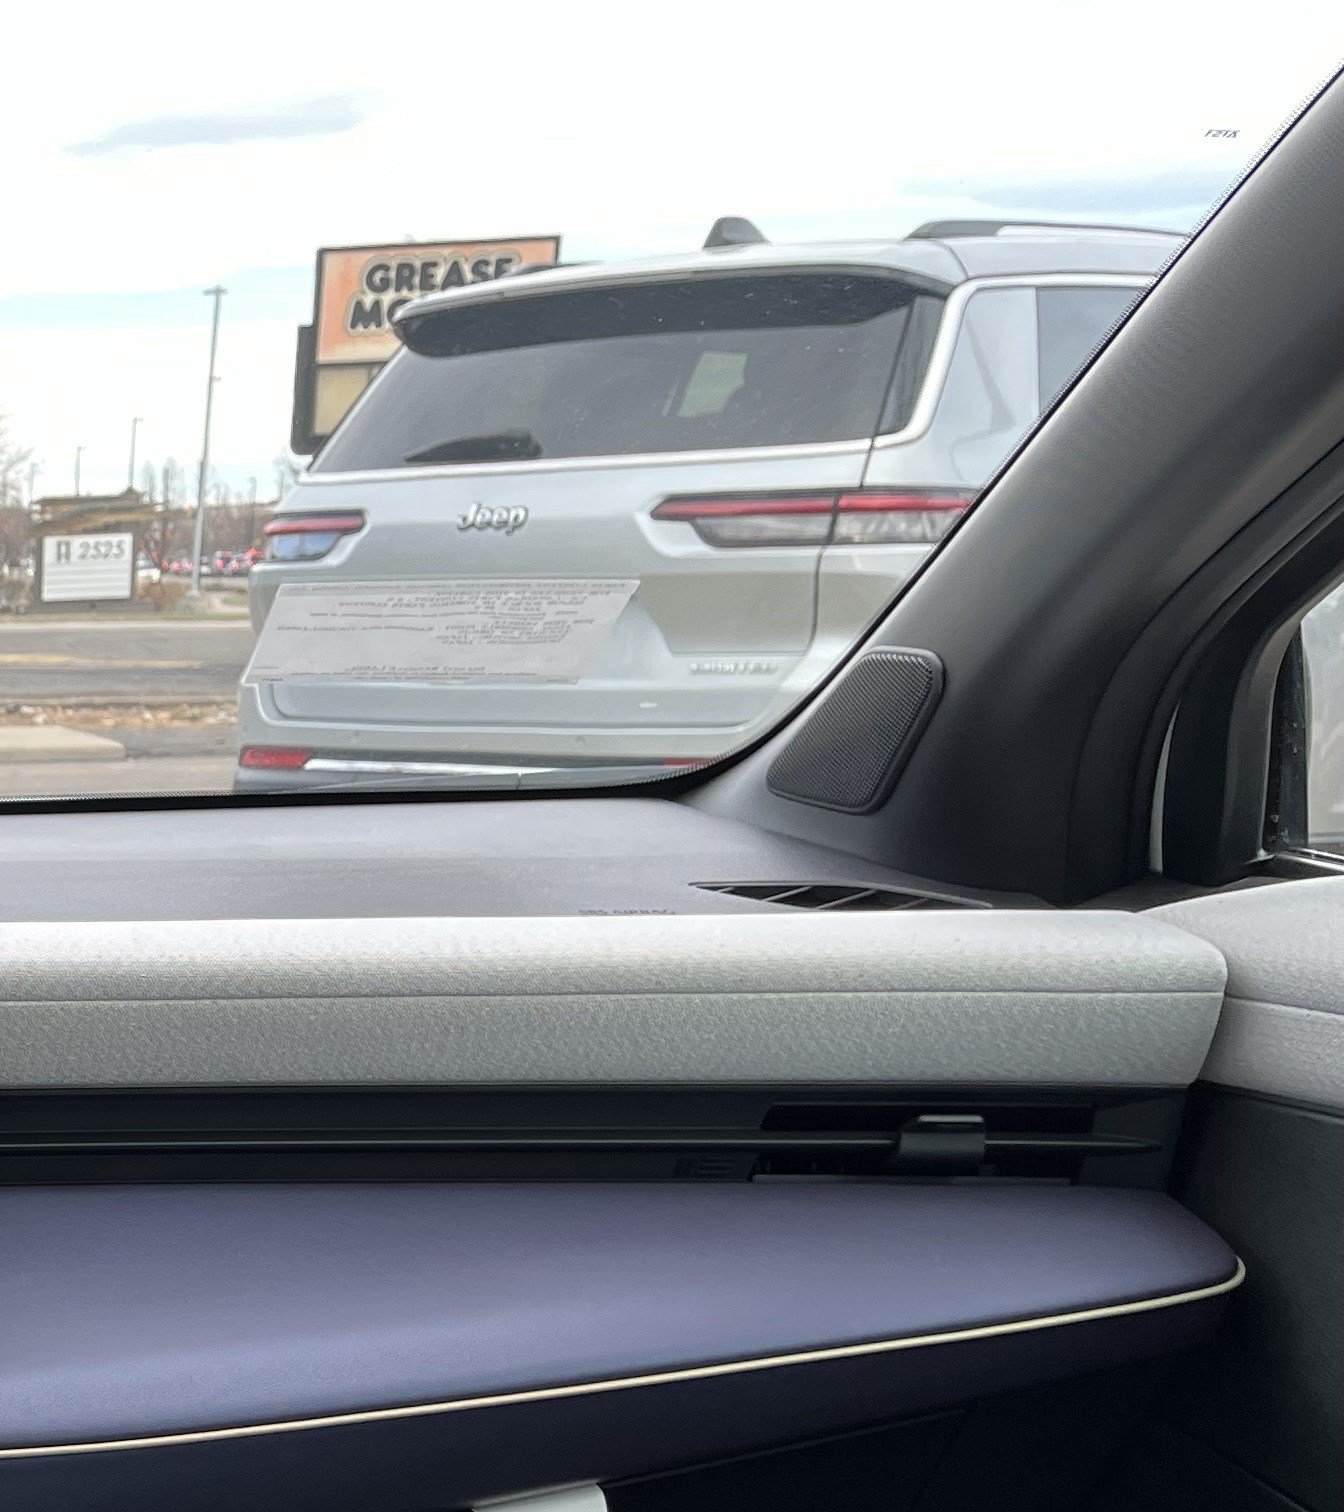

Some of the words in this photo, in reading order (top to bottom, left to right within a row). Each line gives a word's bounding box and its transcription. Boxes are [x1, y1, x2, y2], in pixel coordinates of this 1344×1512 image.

[365, 257, 514, 294] GREASE
[456, 501, 529, 536] Jeep
[77, 539, 126, 560] 2525
